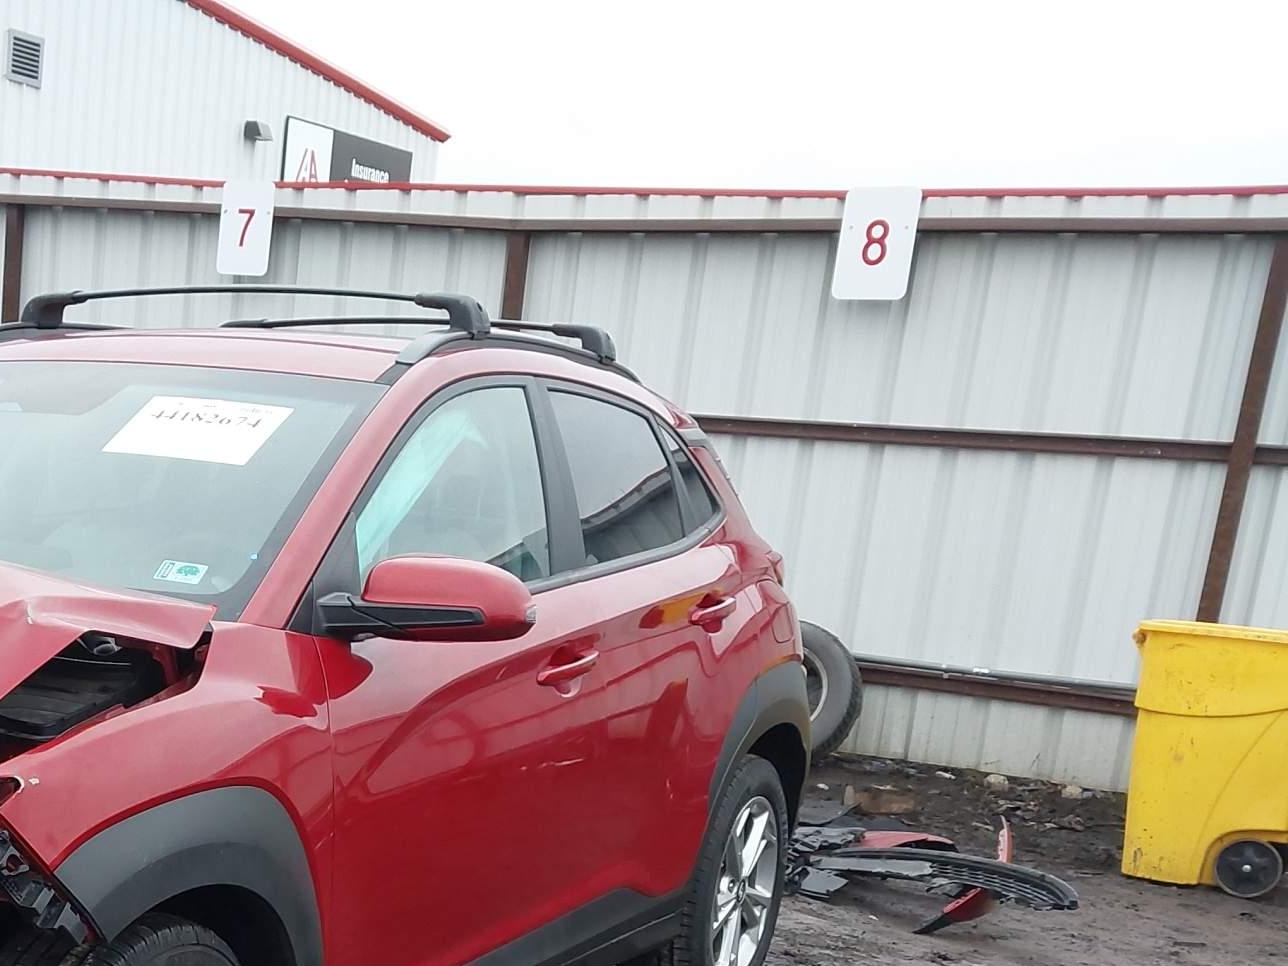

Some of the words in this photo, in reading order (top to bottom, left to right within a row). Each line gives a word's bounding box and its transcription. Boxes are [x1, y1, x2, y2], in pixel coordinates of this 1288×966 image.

[351, 158, 390, 184] Insurance
[238, 208, 256, 247] 7
[862, 219, 890, 266] 8
[151, 409, 262, 429] 44182674
